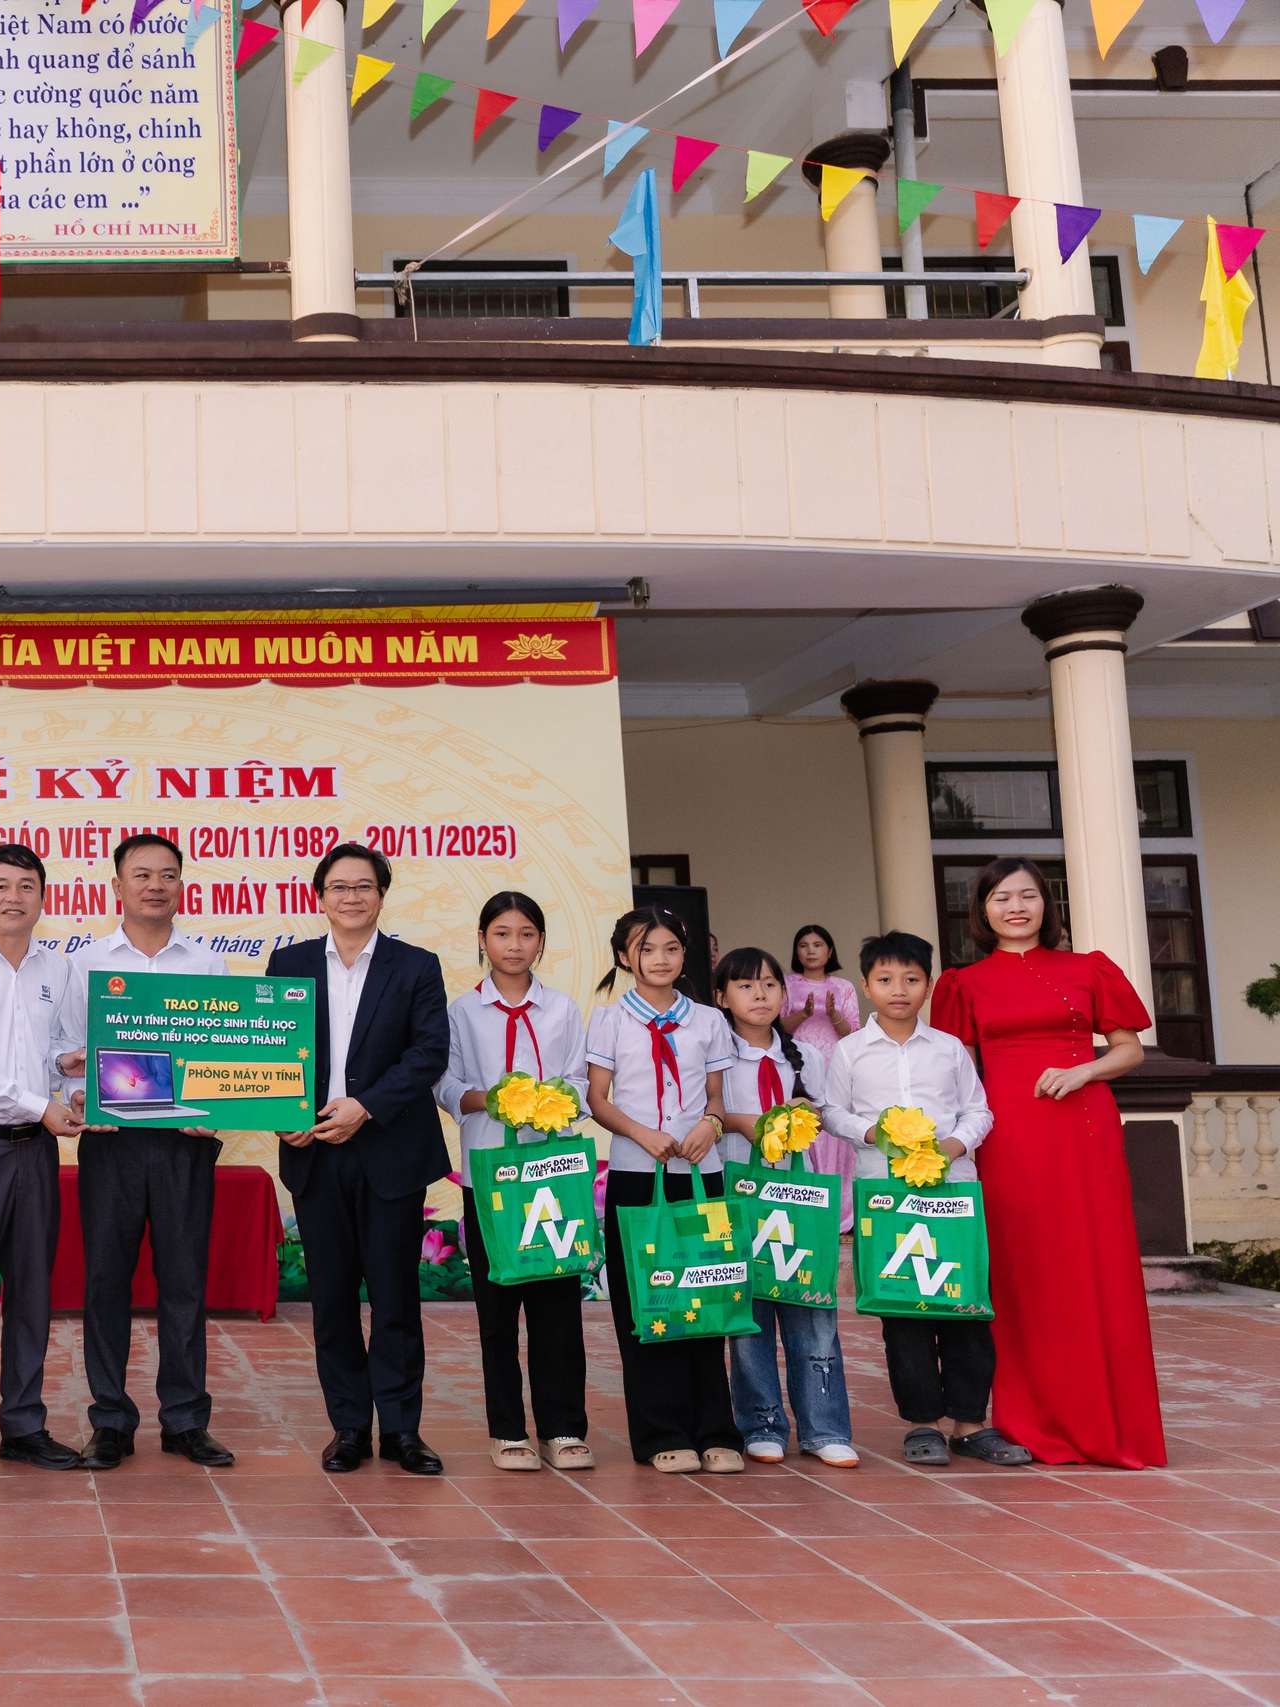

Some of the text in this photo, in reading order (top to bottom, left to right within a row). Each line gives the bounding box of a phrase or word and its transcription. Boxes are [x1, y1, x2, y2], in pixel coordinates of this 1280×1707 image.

[37, 13, 92, 34] Nam
[99, 13, 125, 34] có
[27, 52, 100, 74] quang
[107, 42, 135, 69] để
[141, 47, 196, 69] sánh
[13, 81, 82, 108] cường
[89, 79, 143, 108] quốc
[150, 83, 199, 104] năm
[8, 118, 49, 144] hay
[56, 117, 132, 144] không,
[138, 117, 202, 139] chính
[14, 147, 72, 179] phần
[79, 151, 115, 173] lớn
[122, 149, 136, 173] ở
[141, 151, 196, 178] công
[28, 187, 66, 209] các
[73, 193, 108, 209] em
[54, 218, 197, 236] HỒ CHÍ MINH
[53, 633, 136, 671] VIỆT
[148, 637, 240, 665] NAM
[255, 631, 372, 665] MUÔN
[386, 630, 478, 663] NĂM
[35, 759, 129, 798] KỶ
[156, 760, 337, 803] NIỆM
[58, 820, 112, 866] VIỆT
[189, 826, 339, 862] (20/11/1982
[366, 824, 517, 859] 20/11/2025)
[42, 876, 106, 923] NHẬN
[212, 876, 268, 915] MÁY
[276, 876, 325, 915] TÍN
[210, 935, 265, 957] tháng
[163, 998, 240, 1014] TRAO TẶNG
[106, 1012, 297, 1032] MÁY VI TÍNH CHO HỌC SINH TIỂU HỌC
[116, 1028, 286, 1045] TRƯỜNG TIỂU HỌC QUANG THÀNH
[188, 1066, 301, 1081] PHÒNG MÁY VI TÍNH
[219, 1083, 270, 1093] 20 LAPTOP
[550, 1165, 570, 1173] NAM
[790, 1194, 810, 1202] NAM
[712, 1273, 732, 1282] NAM
